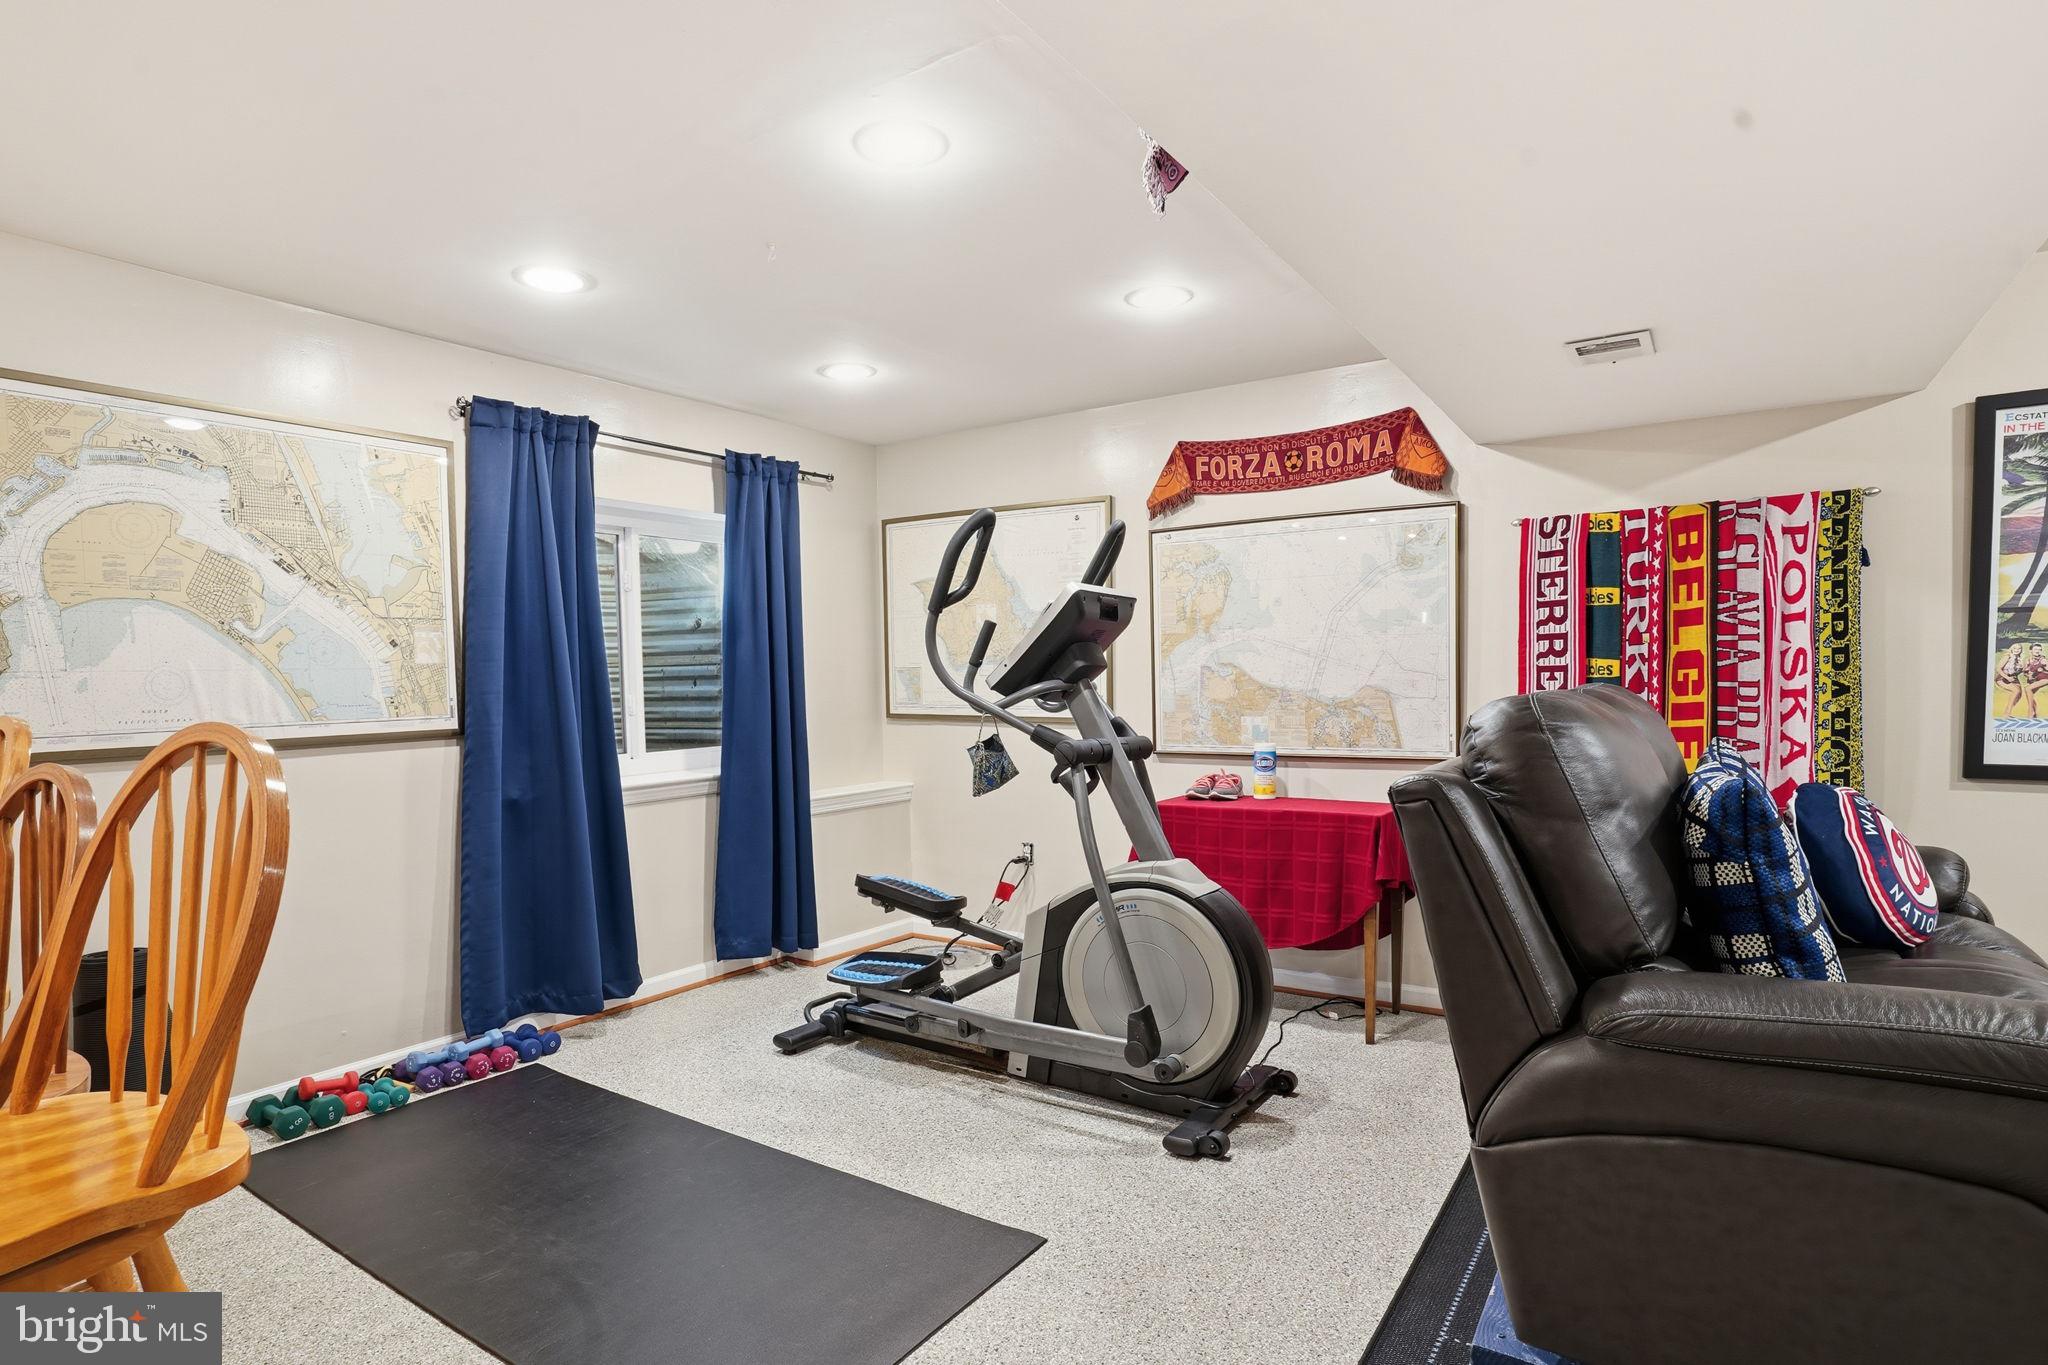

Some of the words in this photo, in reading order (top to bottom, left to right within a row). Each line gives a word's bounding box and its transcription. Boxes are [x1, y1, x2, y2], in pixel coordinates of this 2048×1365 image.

[2003, 424, 2016, 433] IN
[2019, 422, 2045, 431] THE
[1222, 448, 1233, 456] LA
[1235, 445, 1259, 455] ROMA
[1261, 443, 1279, 452] NON
[1281, 442, 1290, 450] SI
[1344, 428, 1364, 439] AMA
[1195, 451, 1282, 481] FORZA
[1306, 429, 1394, 472] ROMA
[1343, 462, 1369, 472] ONORE
[1779, 520, 1808, 771] POLSKA
[1991, 732, 2015, 743] JOAN
